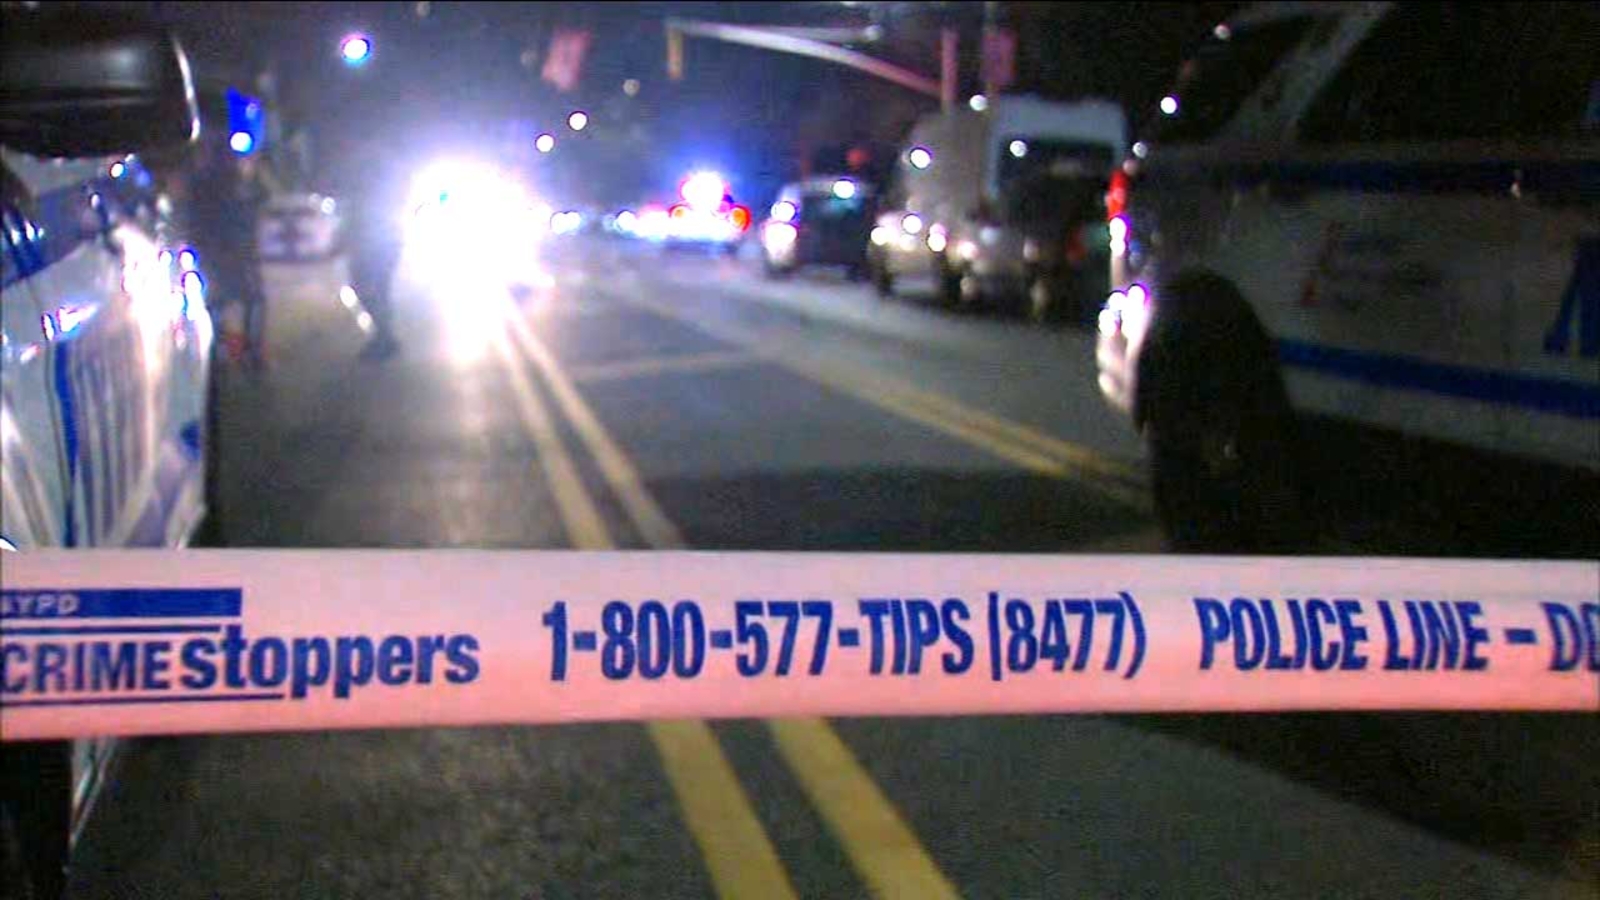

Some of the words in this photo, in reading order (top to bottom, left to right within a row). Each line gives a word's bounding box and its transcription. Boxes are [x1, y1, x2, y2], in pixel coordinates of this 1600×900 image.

[542, 599, 973, 682] 1-800-577-TIPS
[988, 591, 1147, 681] (8477)
[1194, 597, 1368, 671] POLICE
[1376, 599, 1490, 671] LINE
